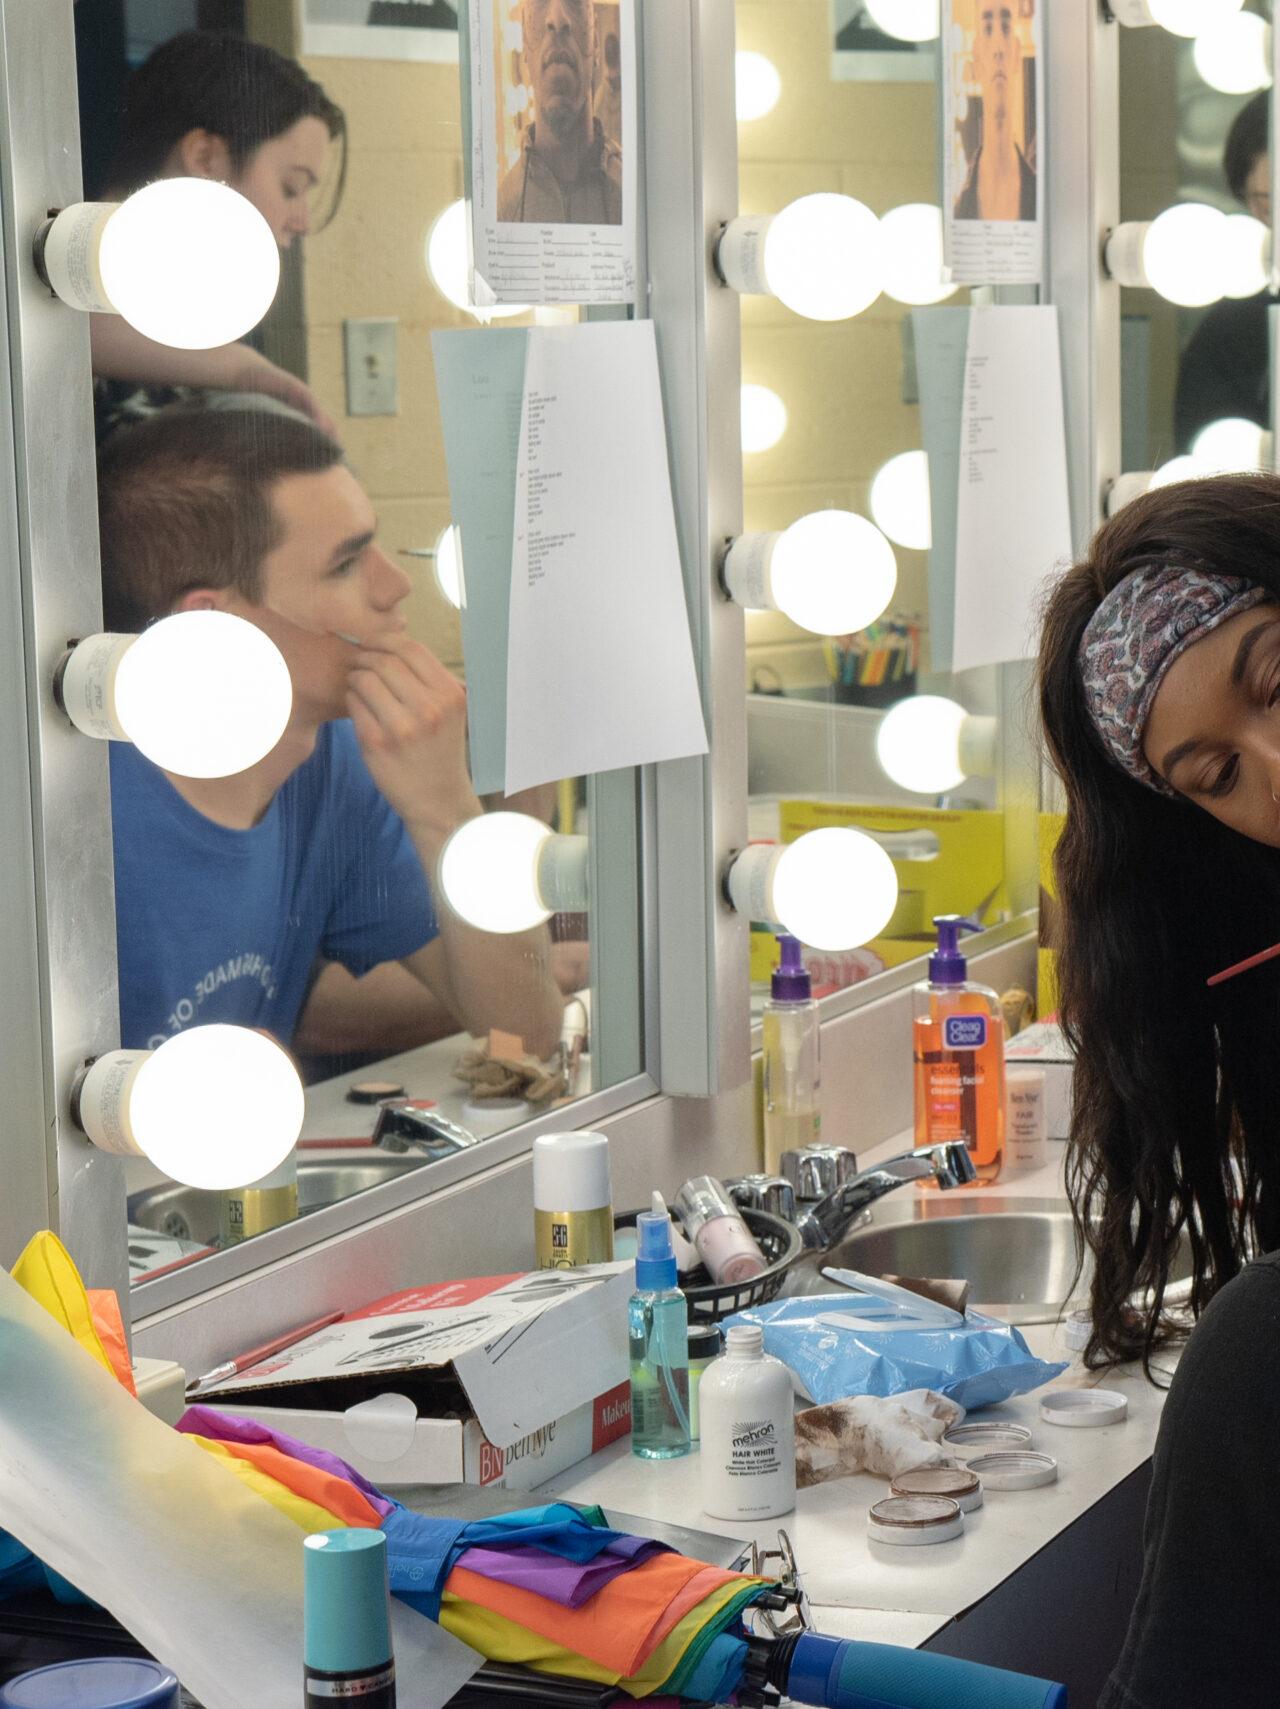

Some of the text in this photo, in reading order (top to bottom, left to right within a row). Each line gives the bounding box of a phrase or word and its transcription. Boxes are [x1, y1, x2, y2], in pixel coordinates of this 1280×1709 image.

[601, 1399, 632, 1430] Makeu
[732, 1423, 774, 1447] mehron
[754, 1448, 775, 1457] WHITE
